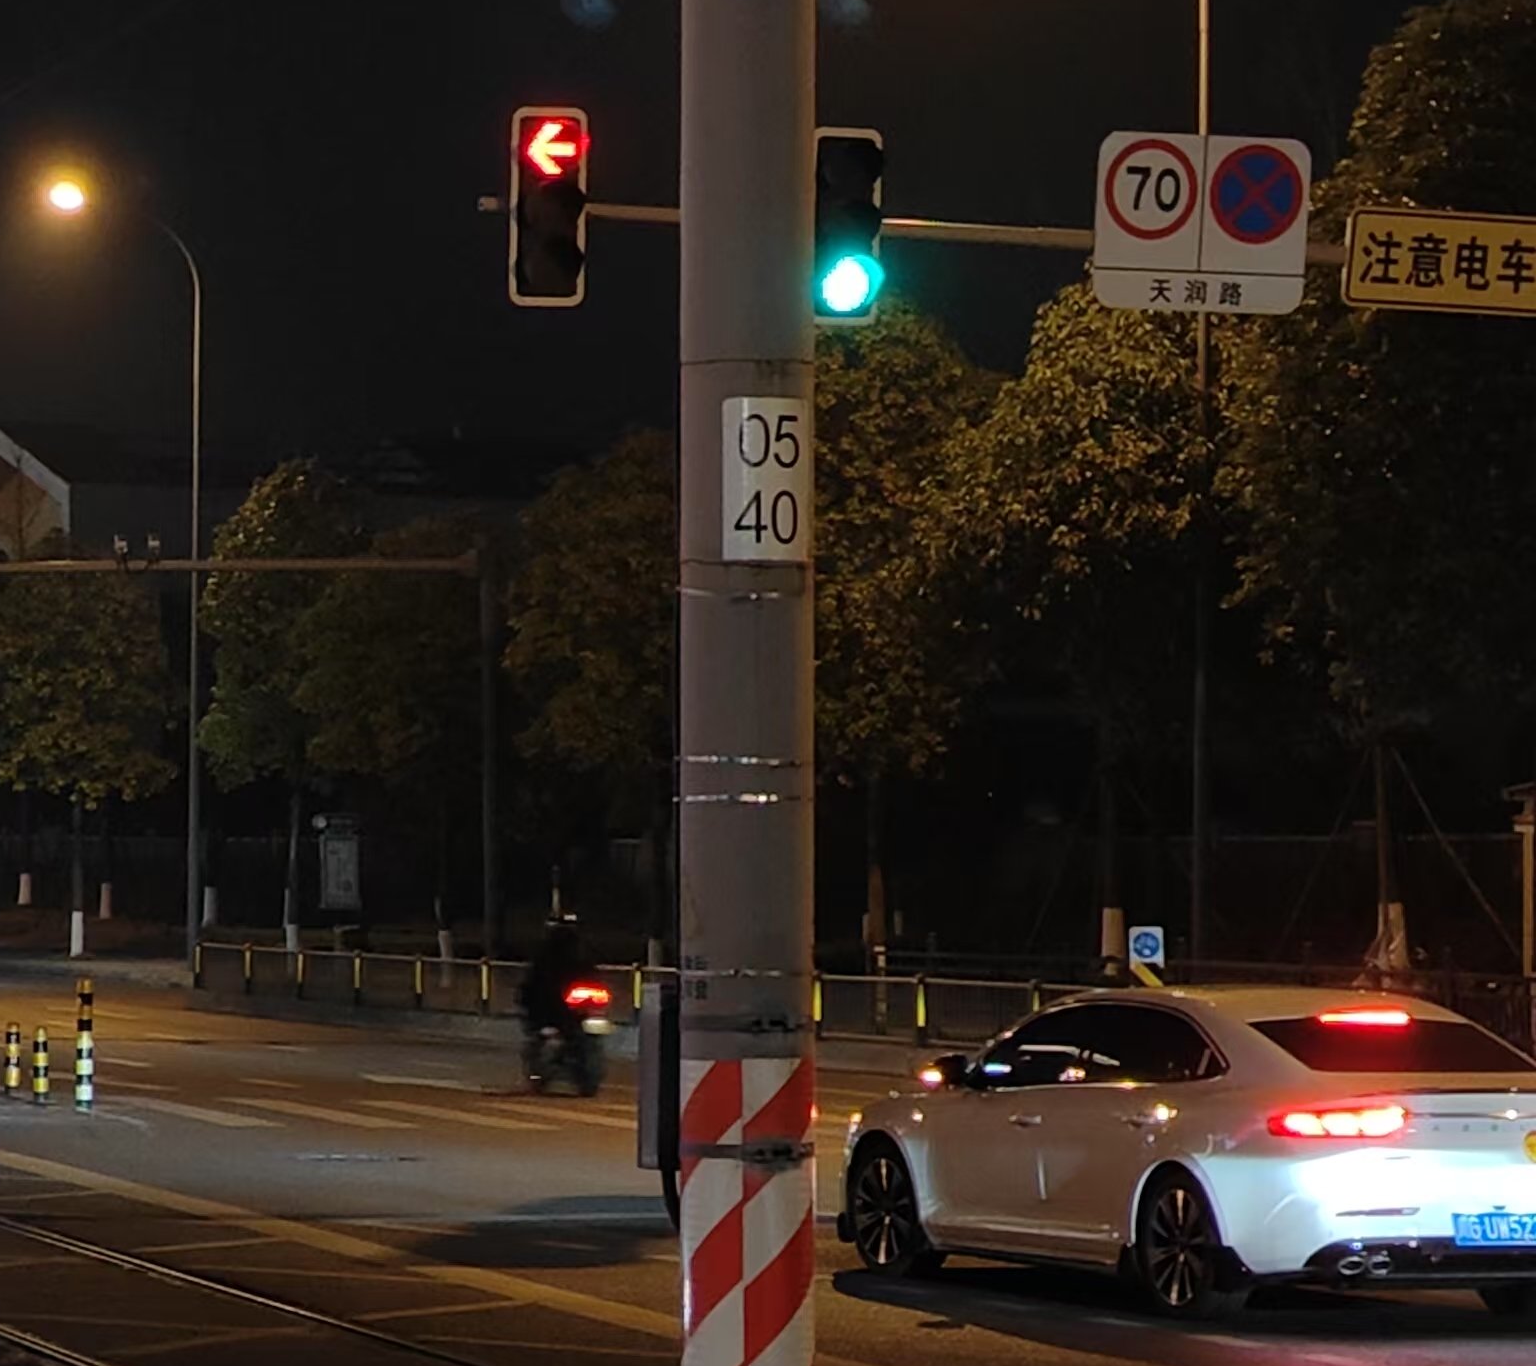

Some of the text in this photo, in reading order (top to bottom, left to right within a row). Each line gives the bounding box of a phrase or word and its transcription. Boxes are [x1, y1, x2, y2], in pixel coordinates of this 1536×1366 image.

[1126, 166, 1181, 212] 70
[1359, 230, 1536, 294] 注意电车
[1149, 279, 1243, 306] 天润路
[738, 413, 800, 469] 05
[733, 490, 798, 545] 40
